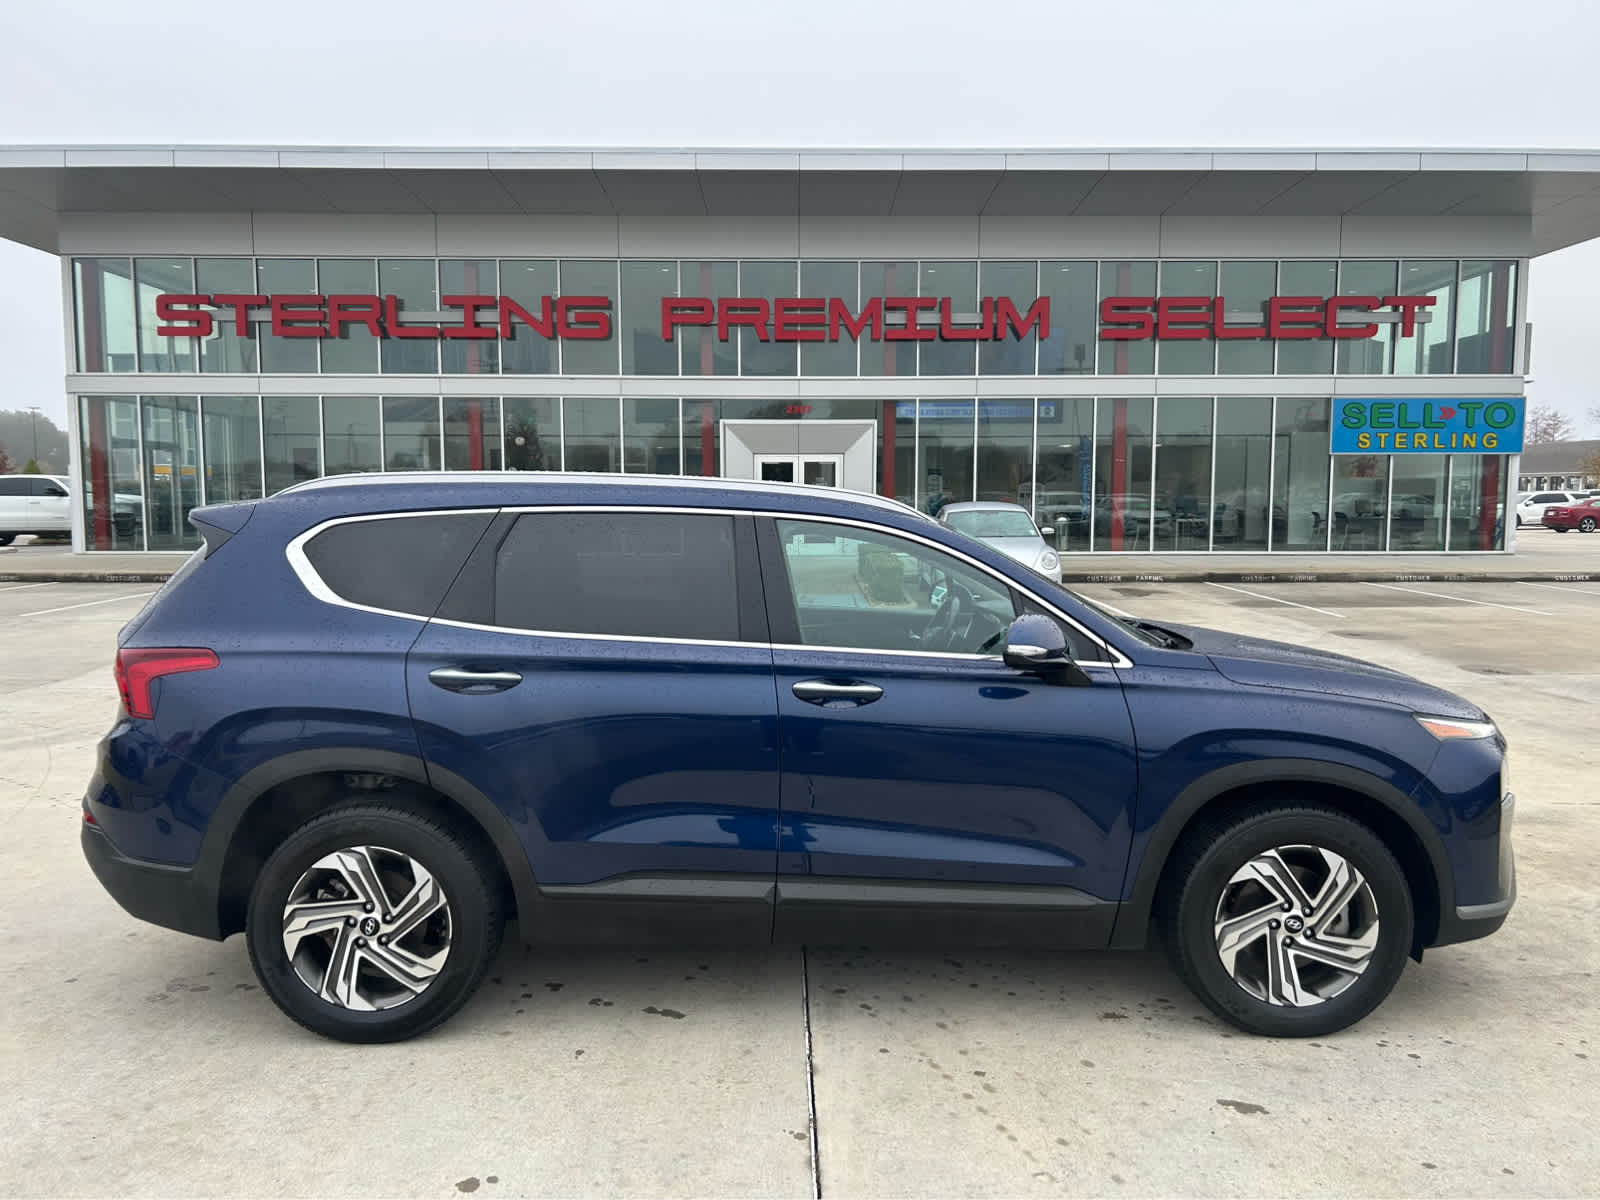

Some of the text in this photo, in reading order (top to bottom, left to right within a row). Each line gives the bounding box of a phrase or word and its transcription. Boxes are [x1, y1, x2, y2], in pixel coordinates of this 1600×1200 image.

[157, 295, 1436, 341] STERLING PREMIUM SELECT
[1342, 402, 1516, 429] SELL TO
[1357, 432, 1499, 449] STERLING
